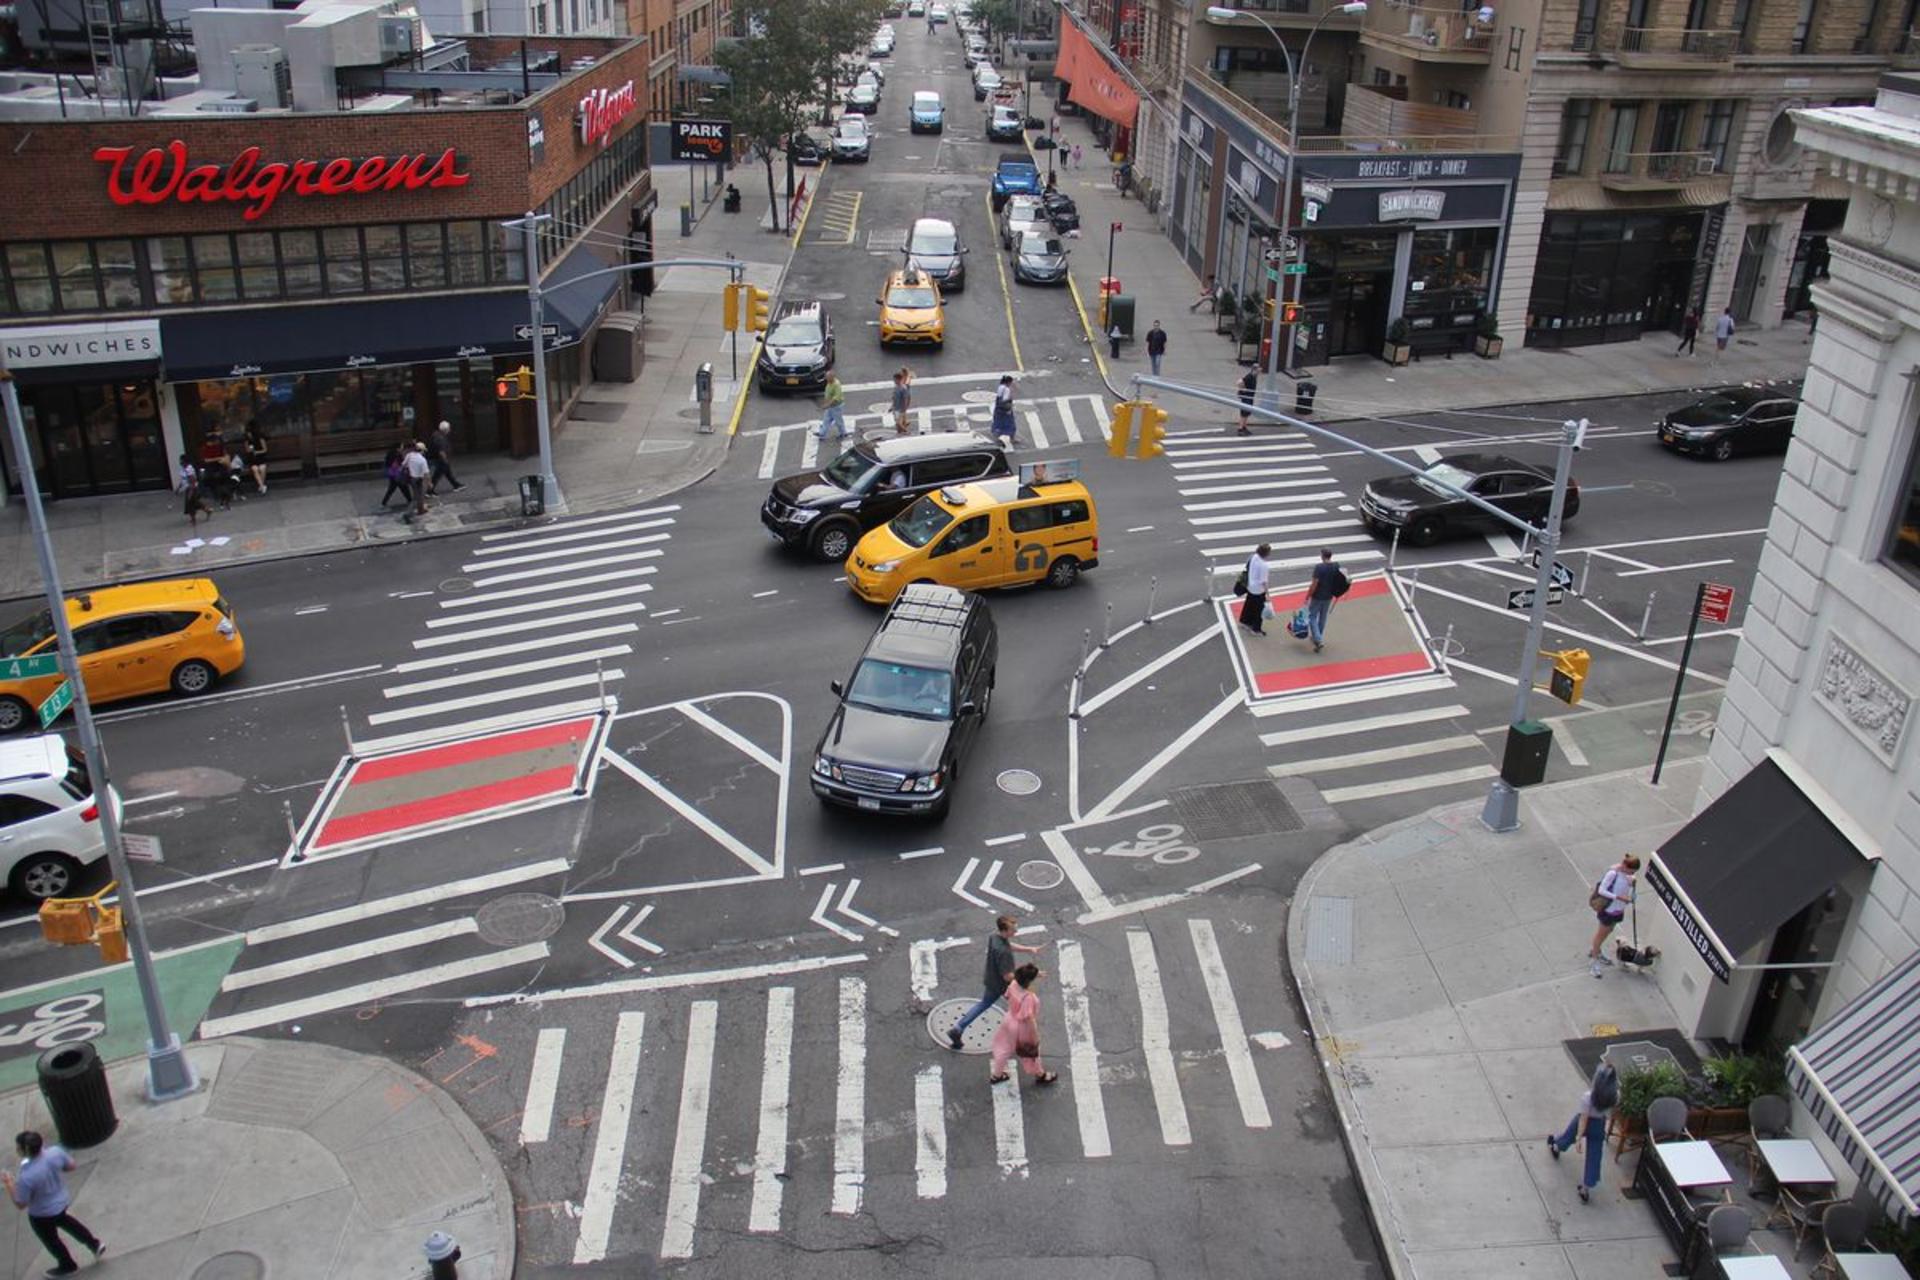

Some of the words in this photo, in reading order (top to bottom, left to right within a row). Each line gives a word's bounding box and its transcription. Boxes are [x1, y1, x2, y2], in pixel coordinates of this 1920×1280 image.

[680, 123, 723, 137] PARK
[1359, 160, 1401, 177] BREAKFAST
[1408, 160, 1434, 175] LUNCH
[1441, 159, 1468, 175] DINNER
[94, 139, 469, 220] Walgreens
[7, 337, 152, 358] NDWICHES
[9, 661, 21, 677] 4
[1670, 898, 1710, 955] DISTILLED
